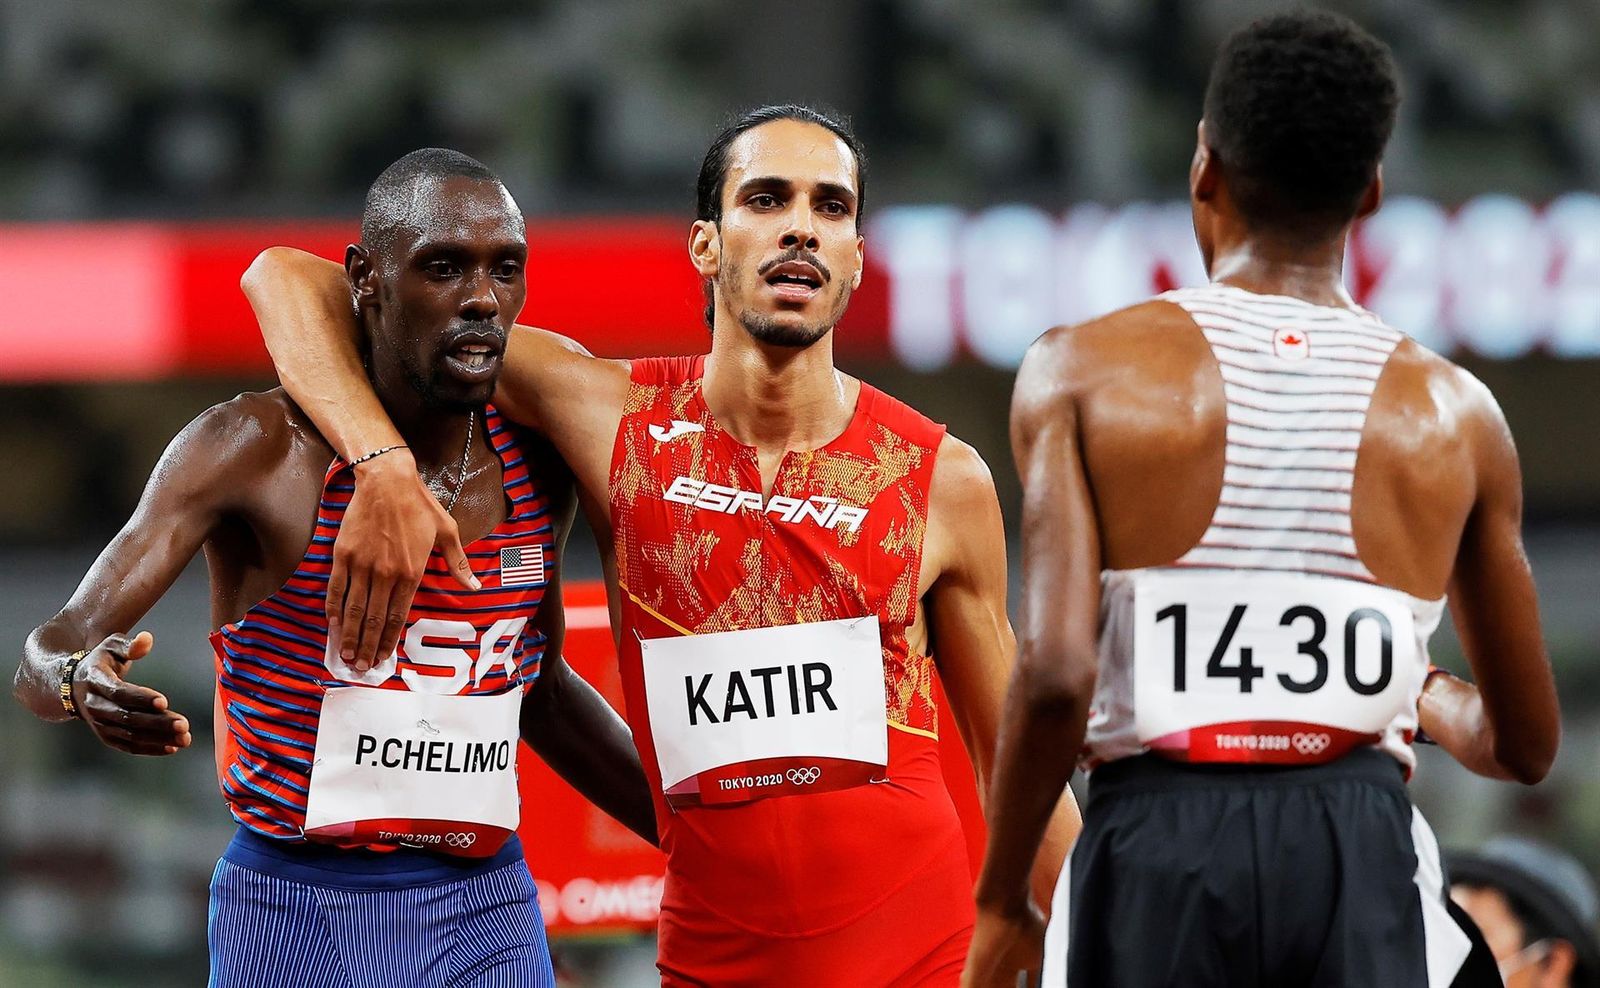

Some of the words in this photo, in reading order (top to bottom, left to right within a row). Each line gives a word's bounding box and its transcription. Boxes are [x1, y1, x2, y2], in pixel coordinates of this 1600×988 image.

[662, 475, 870, 534] ESPAÑA
[1154, 602, 1394, 696] 1430
[684, 661, 838, 727] KATIR
[355, 733, 510, 773] P.CHELIMO
[1215, 733, 1258, 751] TOKYO
[1258, 734, 1291, 751] 2020
[718, 776, 754, 791] TOKYO
[755, 773, 783, 787] 2020
[415, 832, 442, 844] 2020
